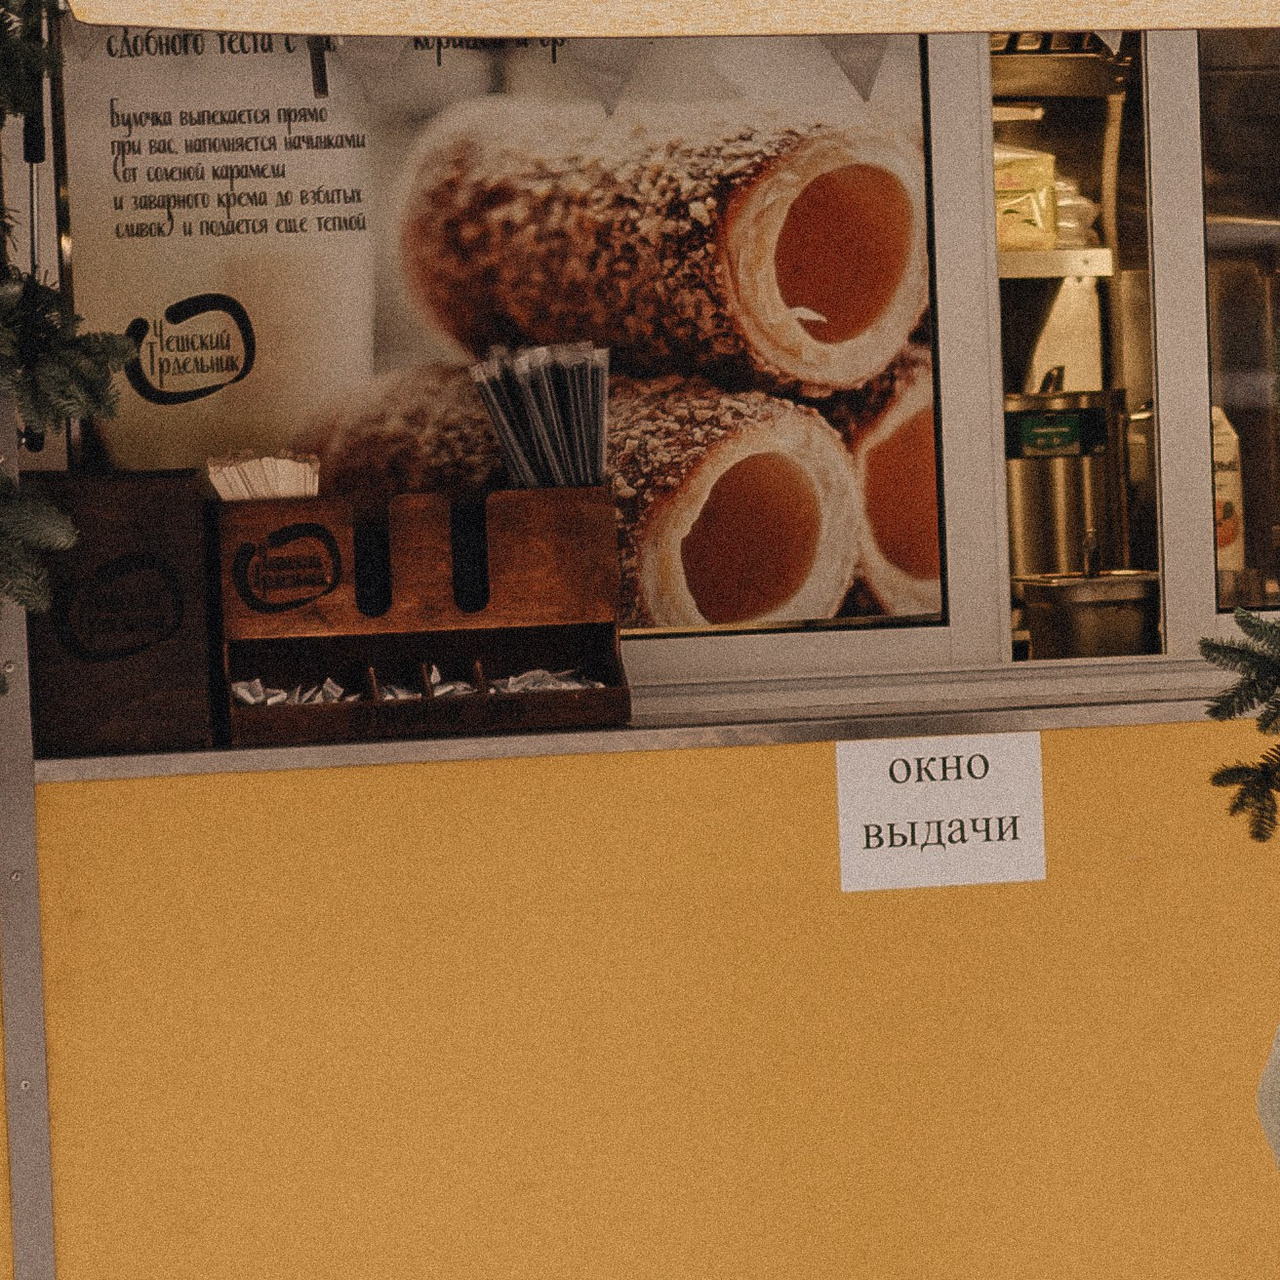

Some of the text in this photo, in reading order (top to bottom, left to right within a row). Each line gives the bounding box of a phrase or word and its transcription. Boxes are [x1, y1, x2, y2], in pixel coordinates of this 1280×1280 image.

[106, 27, 275, 59] сдобного теста
[179, 105, 330, 135] выпекается прямо
[111, 131, 367, 168] при наполняется начинками
[211, 161, 288, 194] карамели
[114, 188, 294, 223] и заварного крема до
[182, 212, 367, 237] и подается еще теплой
[152, 319, 232, 354] Чешский
[148, 340, 241, 389] Трдельник
[888, 753, 990, 784] окно
[862, 815, 1021, 853] выдачи
